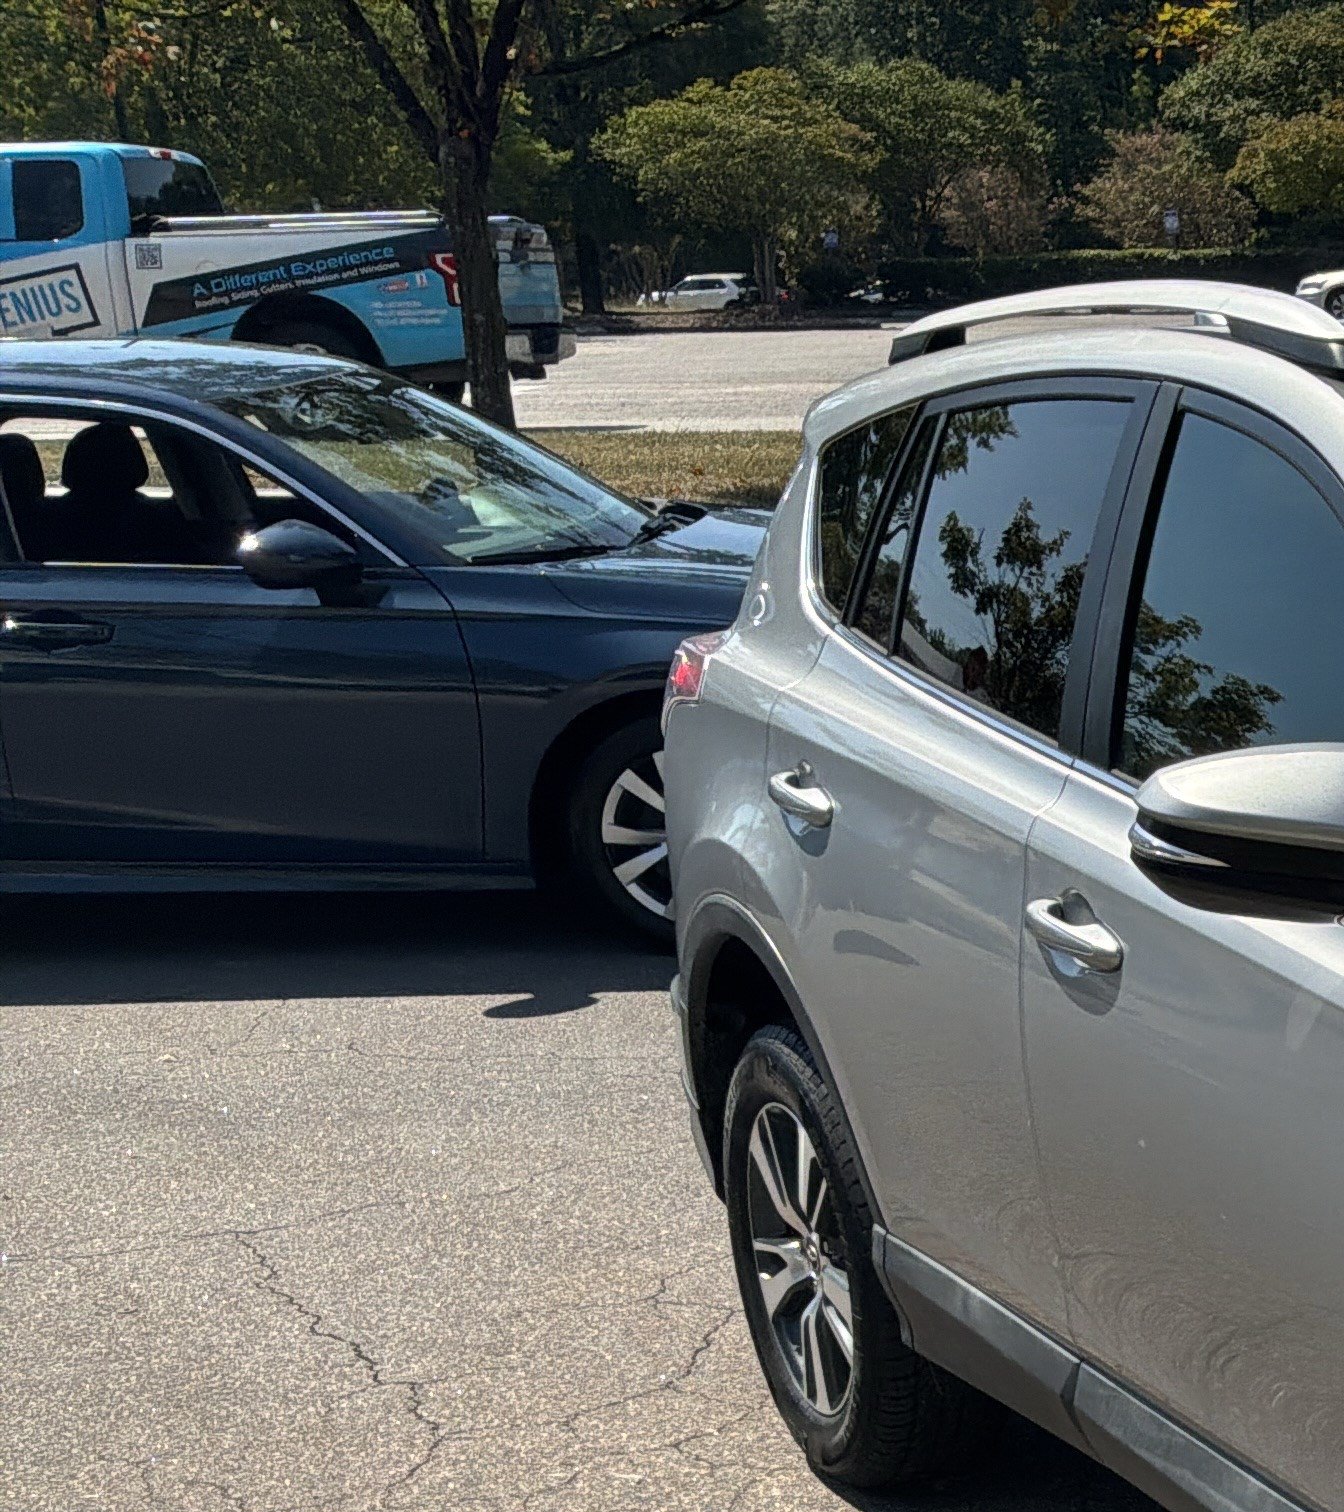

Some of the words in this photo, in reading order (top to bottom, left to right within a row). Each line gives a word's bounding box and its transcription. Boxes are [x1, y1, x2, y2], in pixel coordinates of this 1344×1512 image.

[193, 282, 208, 298] A
[210, 265, 288, 294] Different
[290, 246, 395, 277] Experience
